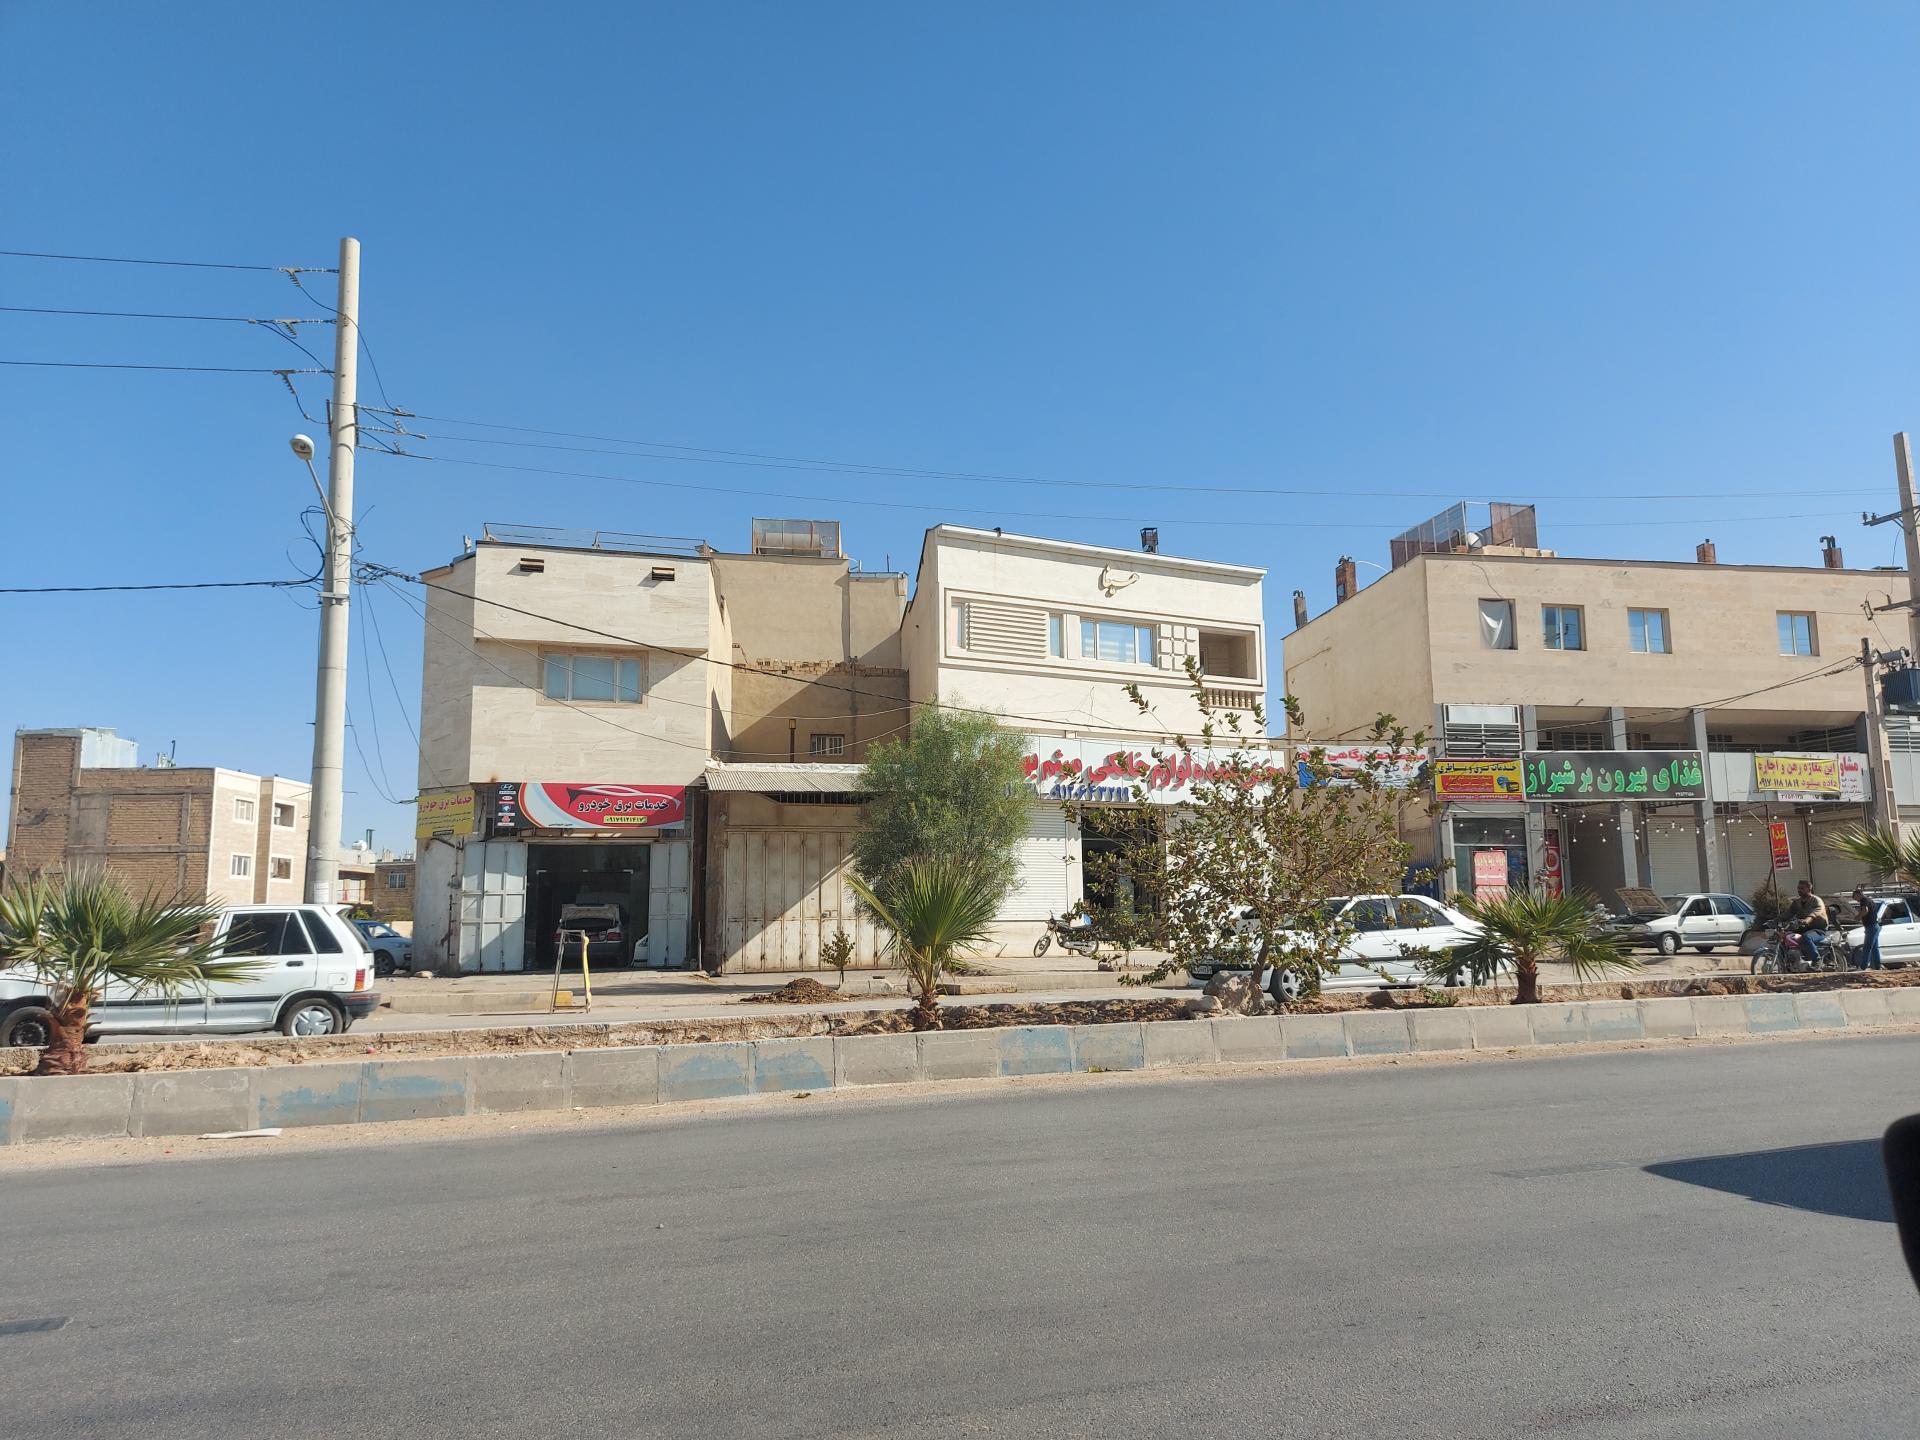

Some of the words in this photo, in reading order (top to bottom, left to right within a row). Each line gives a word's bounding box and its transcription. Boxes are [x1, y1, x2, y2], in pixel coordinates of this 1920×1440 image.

[1087, 751, 1150, 783] خانگی
[1151, 753, 1192, 789] لوازم
[1758, 760, 1778, 774] اجاره
[1804, 762, 1822, 776] مغازه
[1526, 759, 1575, 792] شیراز
[1578, 767, 1593, 792] بر
[1597, 766, 1648, 792] بیرون
[1652, 759, 1702, 792] غذای
[418, 801, 438, 813] خودرو
[450, 795, 473, 806] خدمات
[577, 797, 611, 813] خودرو
[613, 799, 633, 813] برق
[633, 798, 669, 811] خدمات
